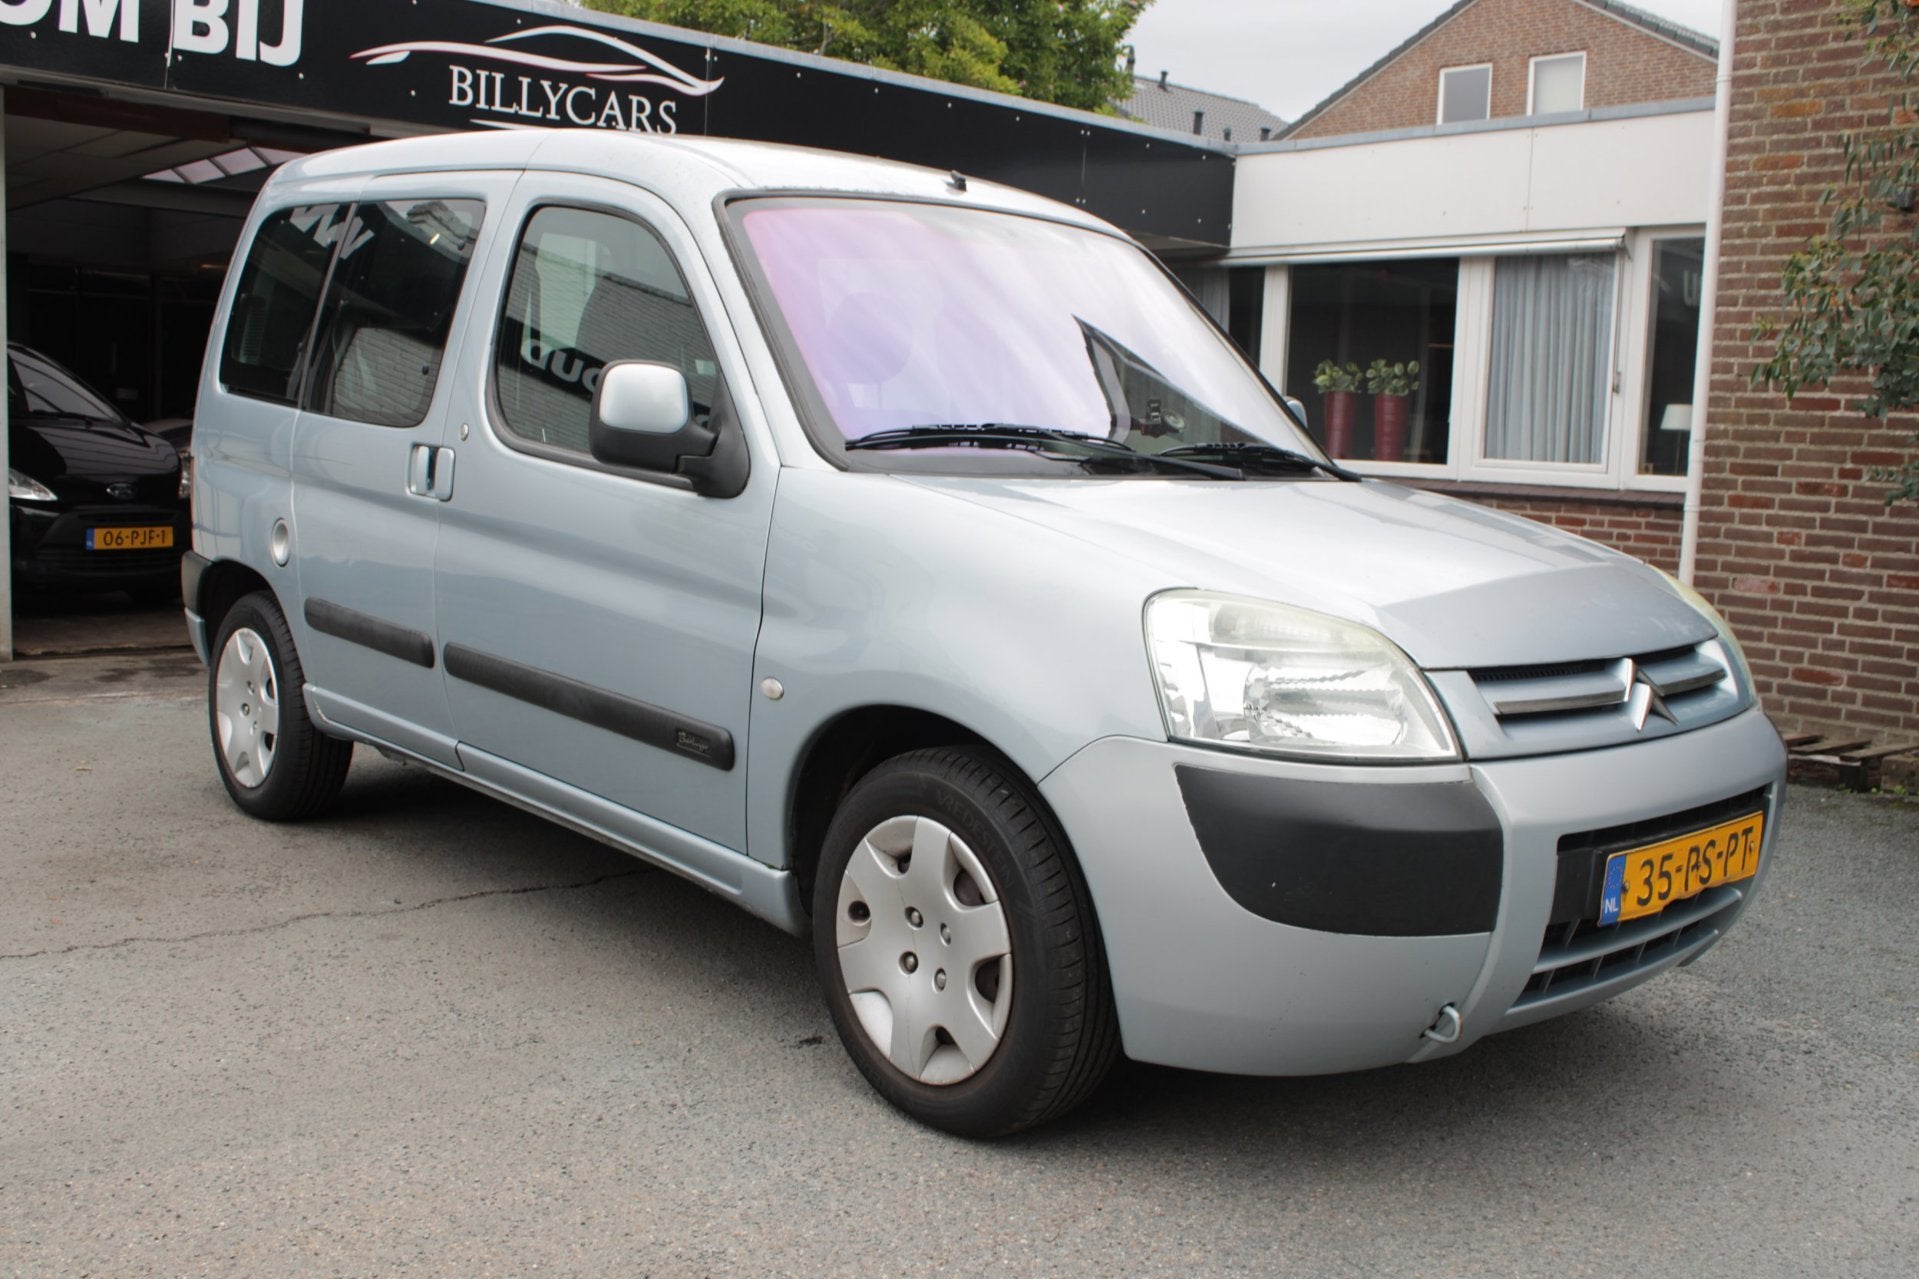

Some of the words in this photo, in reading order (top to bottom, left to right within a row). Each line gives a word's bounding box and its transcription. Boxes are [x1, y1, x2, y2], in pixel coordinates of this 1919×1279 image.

[172, 0, 304, 67] BIJ
[448, 65, 677, 135] BILLYCARS
[103, 529, 166, 546] 06-PJF-1
[1604, 898, 1619, 913] NL
